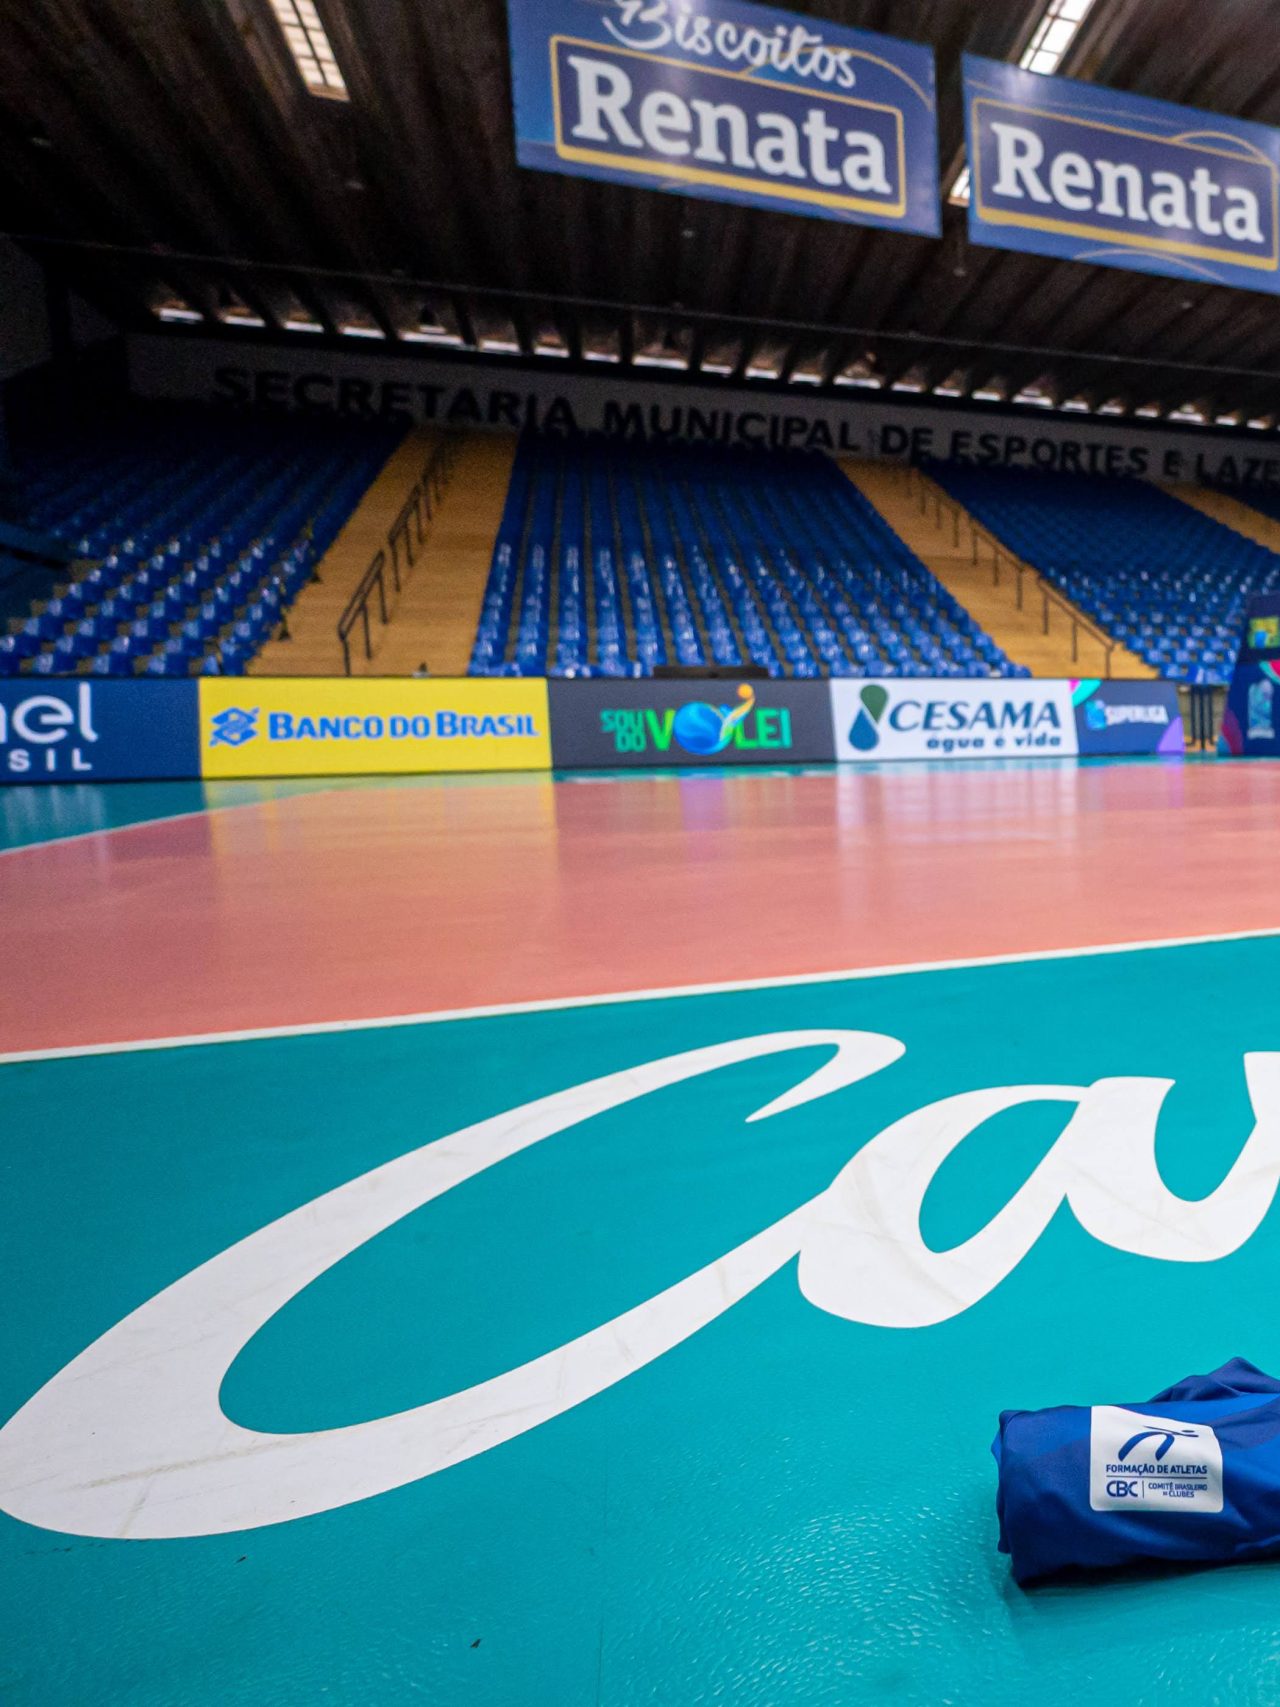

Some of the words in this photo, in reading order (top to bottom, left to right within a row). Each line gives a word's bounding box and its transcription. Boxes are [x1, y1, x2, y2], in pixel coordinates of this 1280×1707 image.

[603, 0, 857, 88] Biscoitos
[568, 55, 892, 194] Renata
[990, 123, 1265, 242] Renata
[214, 367, 577, 436] SECRETARIA
[604, 400, 858, 454] MUNICIPAL
[880, 423, 932, 458] DE
[951, 431, 1147, 478] ESPORTES
[1163, 451, 1182, 476] E
[0, 682, 98, 743] el
[268, 712, 383, 741] BANCO
[390, 716, 430, 737] DO
[436, 711, 539, 738] BRASIL
[889, 701, 1061, 731] CESAMA
[1014, 733, 1061, 747] vida
[1106, 1464, 1155, 1475] FORMAÇÃO
[1157, 1466, 1168, 1474] DE
[1170, 1465, 1207, 1474] ATLETAS
[1106, 1480, 1138, 1497] CBC
